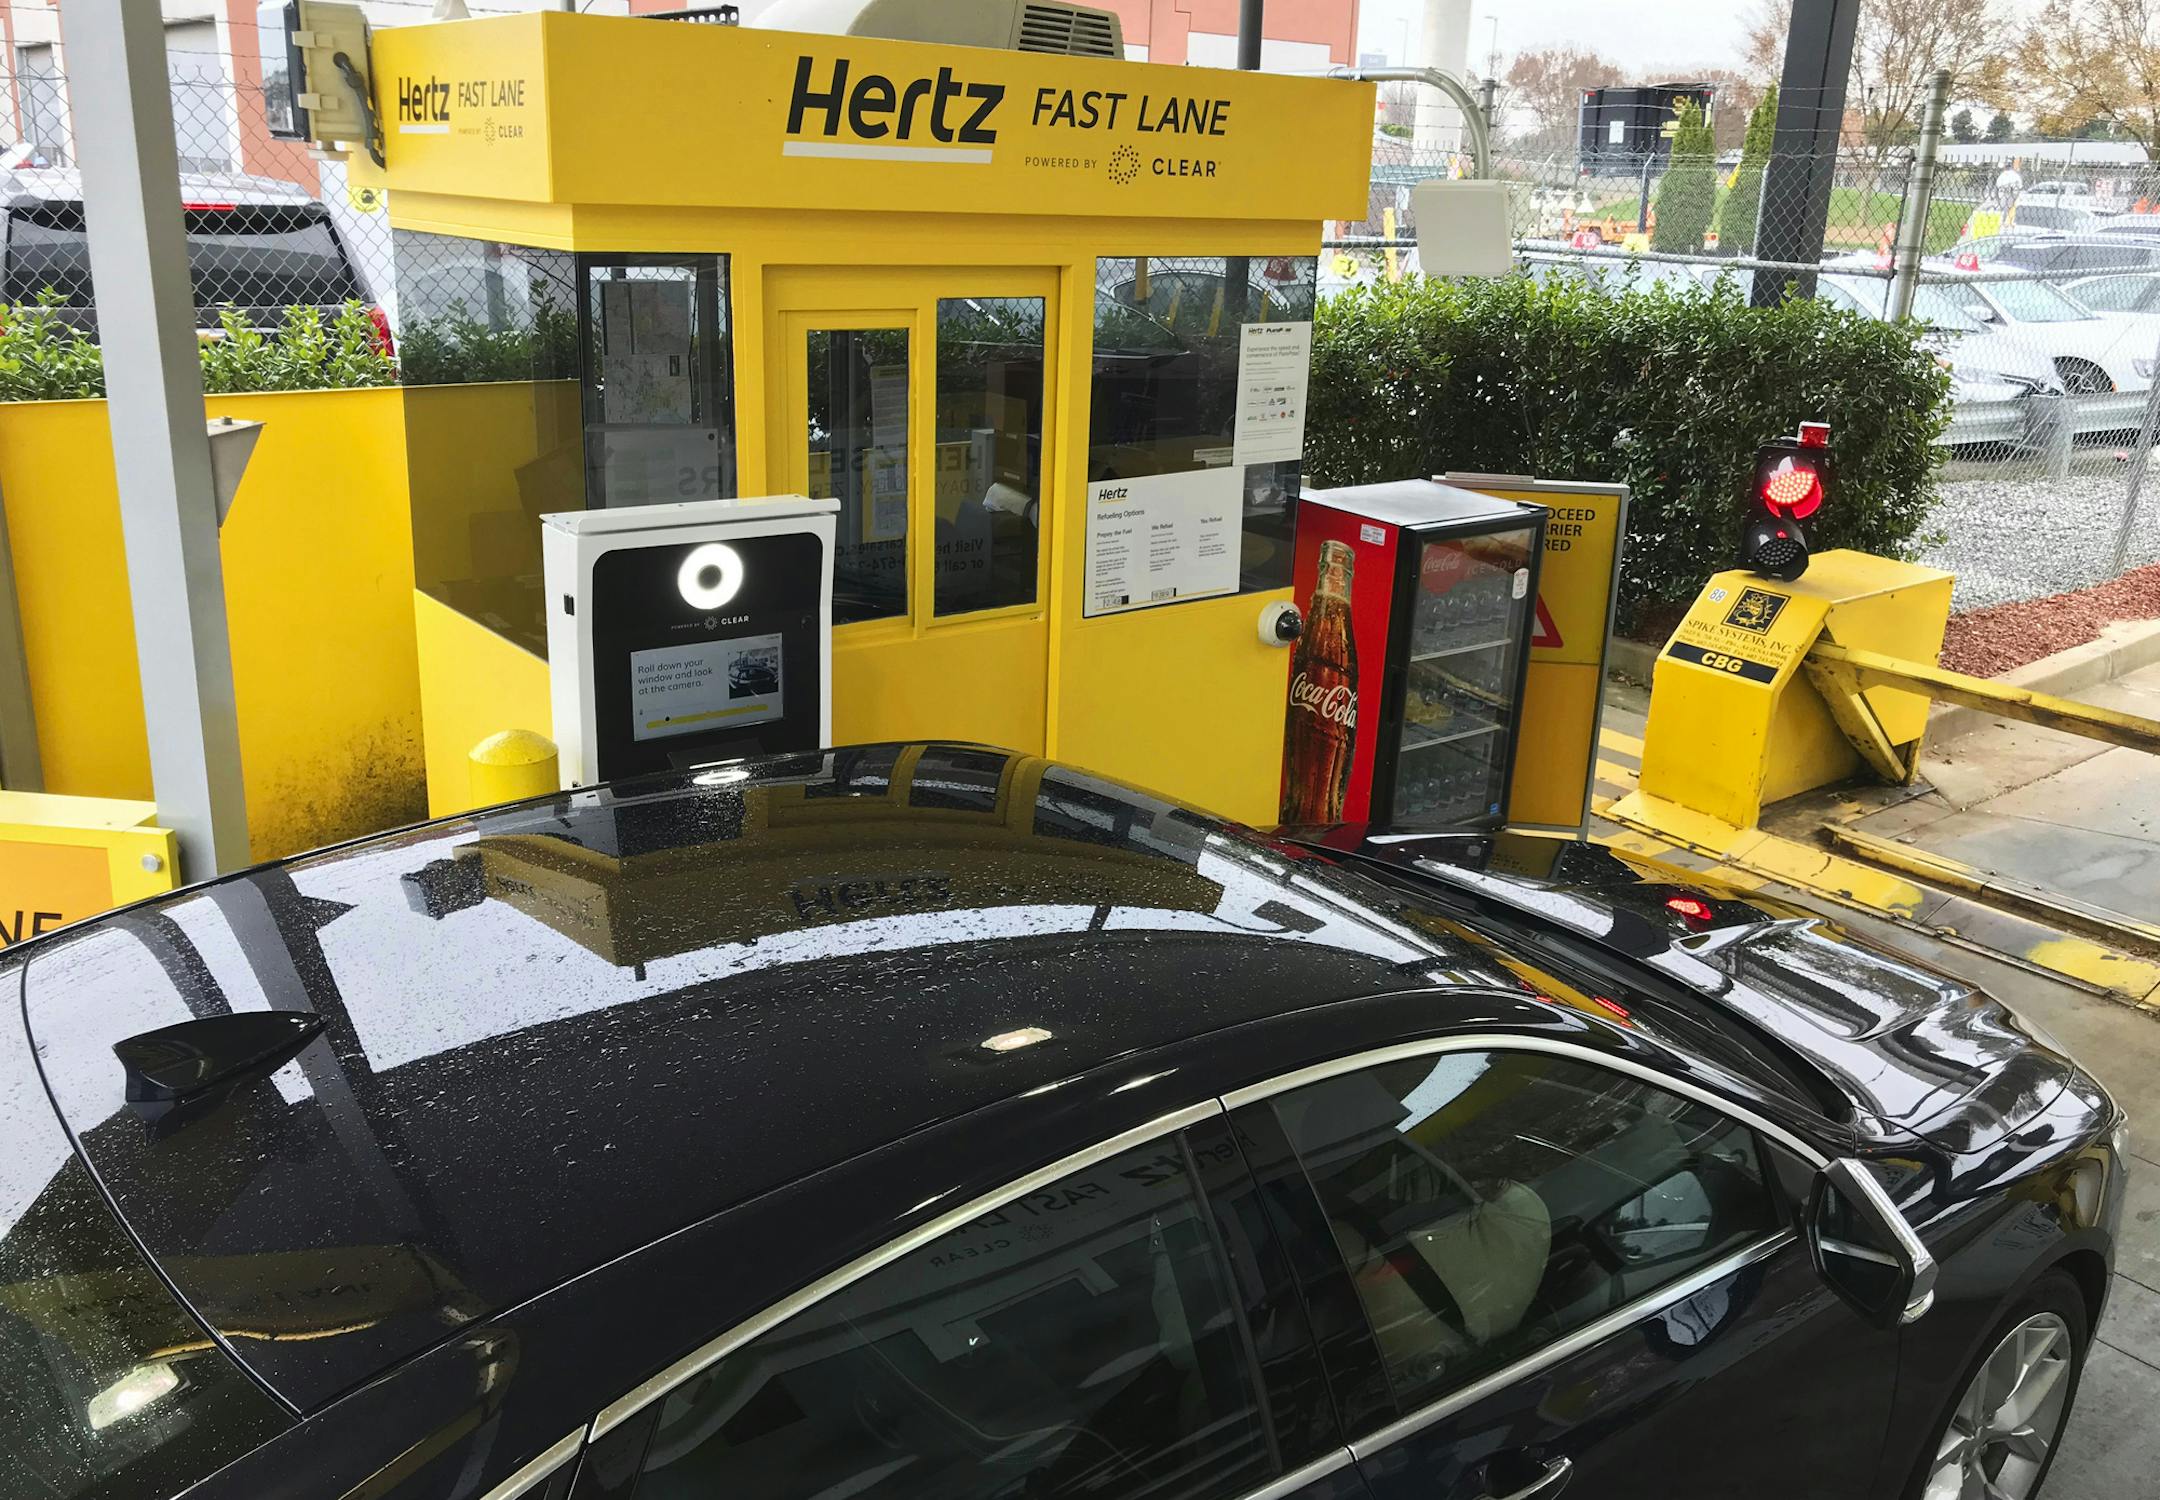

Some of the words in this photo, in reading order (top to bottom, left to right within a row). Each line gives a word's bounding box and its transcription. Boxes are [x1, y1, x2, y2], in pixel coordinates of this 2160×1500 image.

[398, 75, 450, 121] Hertz
[458, 81, 487, 107] FAST
[491, 79, 525, 107] LANE
[786, 56, 1005, 144] Hertz
[1031, 87, 1126, 130] FAST
[1137, 95, 1231, 136] LANE
[498, 125, 523, 138] CLEAR
[1025, 157, 1079, 168] POWERED
[1084, 159, 1097, 169] BY
[1152, 158, 1217, 177] CLEAR
[1098, 487, 1128, 501] Hertz
[1097, 511, 1122, 520] Refueling
[1123, 509, 1145, 519] Options
[1548, 507, 1595, 521] OCEED
[1096, 531, 1112, 539] Prepay
[721, 615, 749, 625] CLEAR
[1687, 619, 1716, 634] SPIKE
[1720, 627, 1766, 649] SYSTEMS,
[1770, 641, 1792, 654] INC.
[638, 663, 655, 674] Roll
[657, 662, 682, 671] down
[684, 659, 704, 668] your
[1701, 652, 1743, 673] CBG
[638, 674, 672, 685] window
[674, 669, 692, 679] and
[693, 667, 713, 677] look
[638, 687, 648, 695] at
[650, 684, 666, 693] the
[668, 680, 704, 691] camera.
[1289, 671, 1358, 729] Coca-Cola
